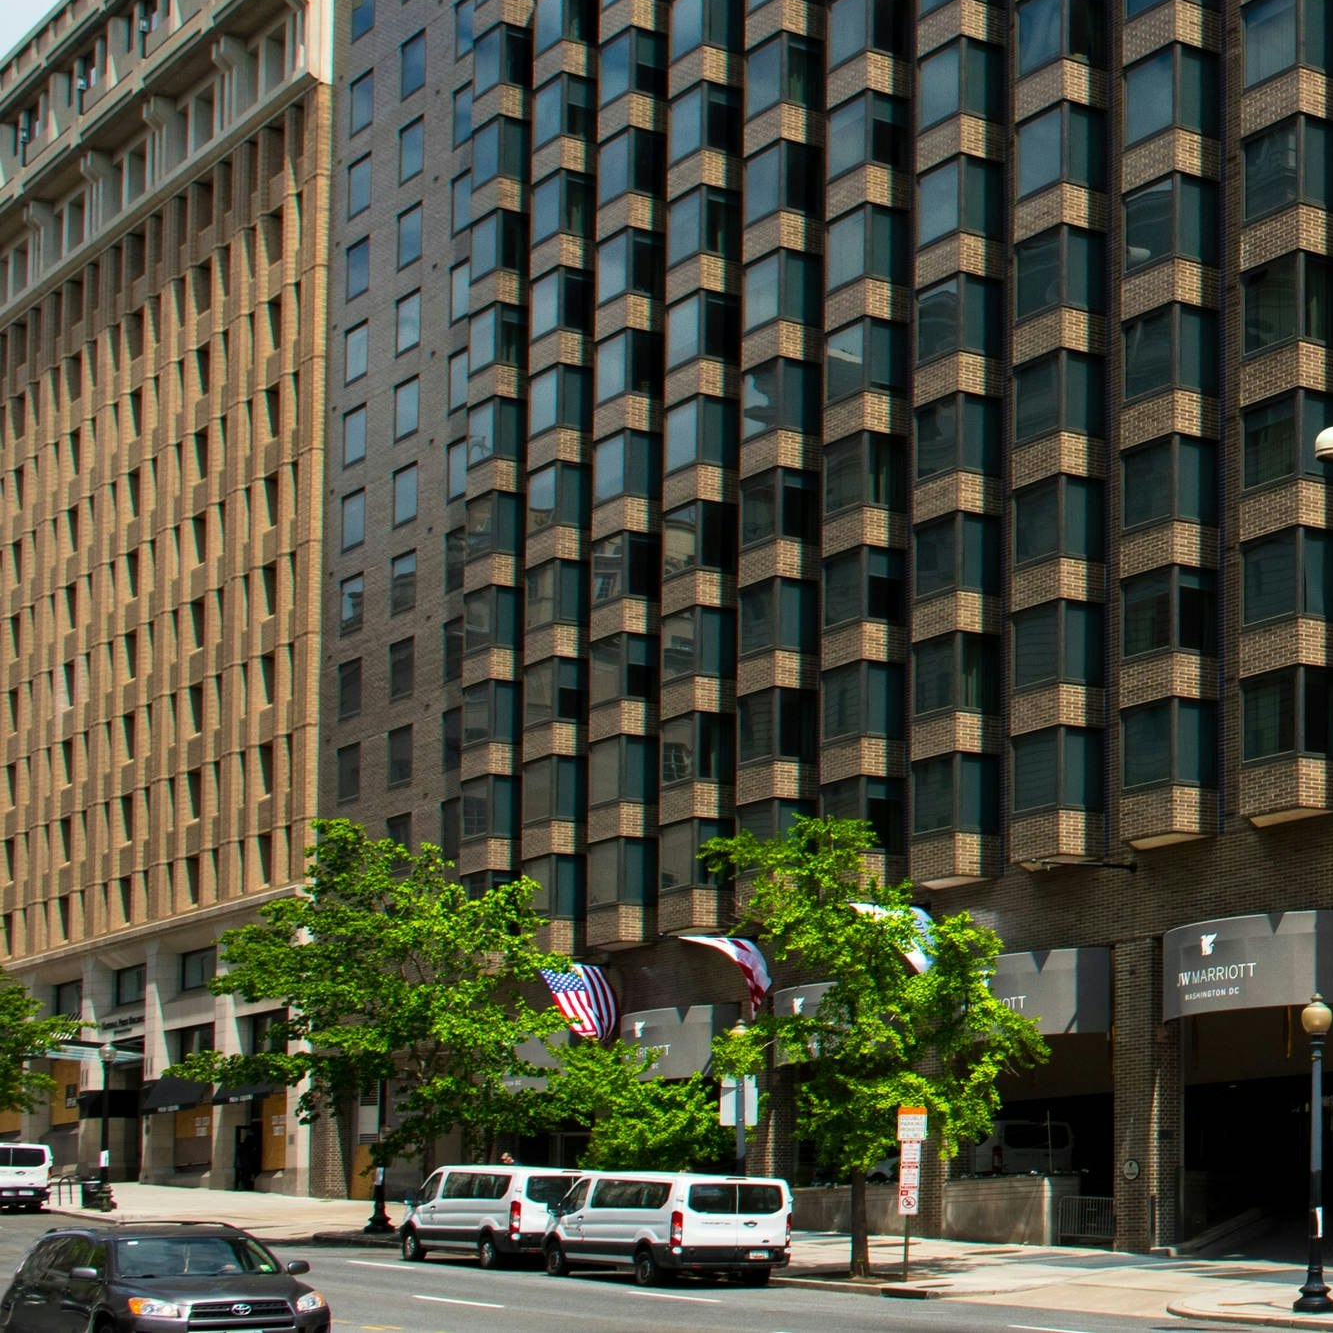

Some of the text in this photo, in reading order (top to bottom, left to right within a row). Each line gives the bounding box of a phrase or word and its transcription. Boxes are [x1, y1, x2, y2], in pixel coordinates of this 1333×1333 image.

[1177, 962, 1257, 986] JW MARRIOTT
[1184, 986, 1240, 1001] WASHINGTON DC
